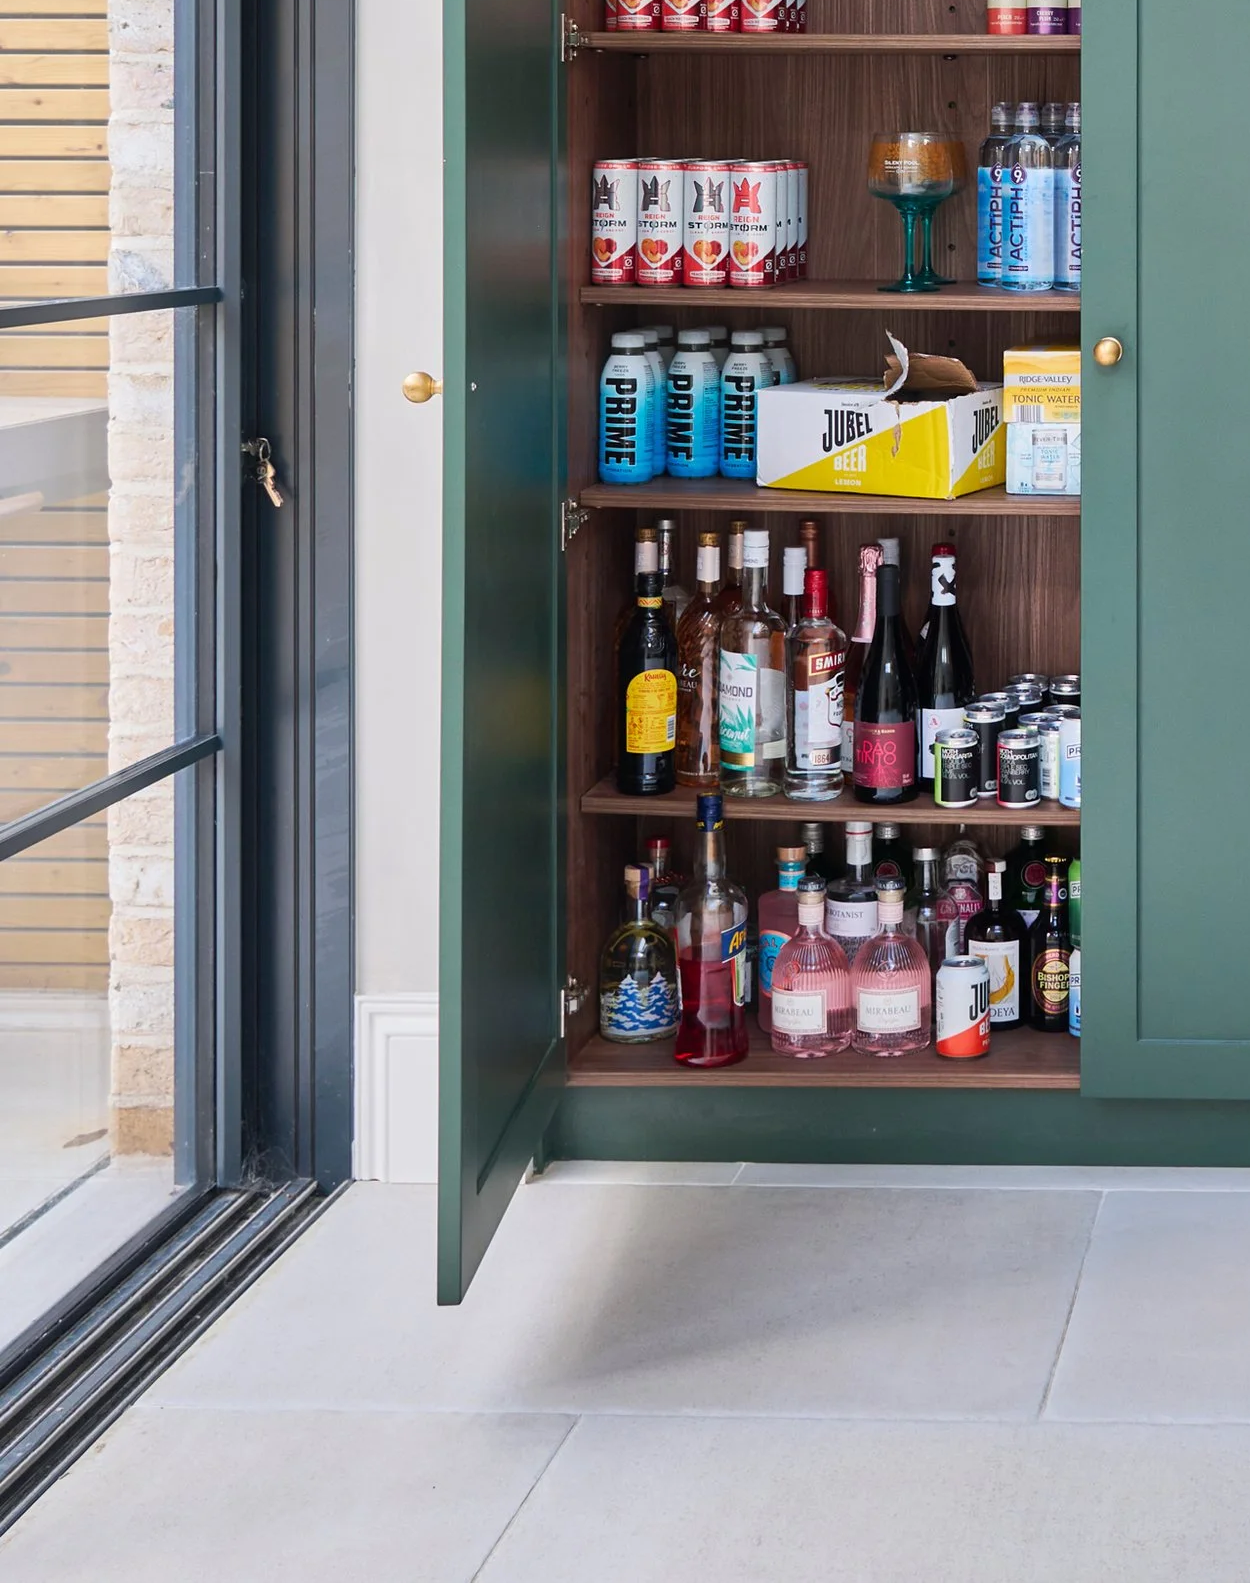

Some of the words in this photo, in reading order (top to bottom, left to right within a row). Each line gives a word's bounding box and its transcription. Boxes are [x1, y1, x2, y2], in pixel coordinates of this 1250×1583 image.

[688, 221, 729, 230] STORM
[1012, 394, 1044, 404] TONIC
[1046, 394, 1081, 404] WATER
[605, 377, 638, 466] PRIME
[666, 374, 694, 461] PRIME
[724, 375, 755, 461] PRIME
[822, 408, 873, 453] JUBEL
[972, 405, 999, 454] JUBEL
[833, 444, 867, 472] BEER
[977, 440, 996, 470] BEER
[814, 755, 831, 764] 1864
[774, 1004, 815, 1017] MIRABEAU
[864, 1005, 912, 1016] MIRABEAU
